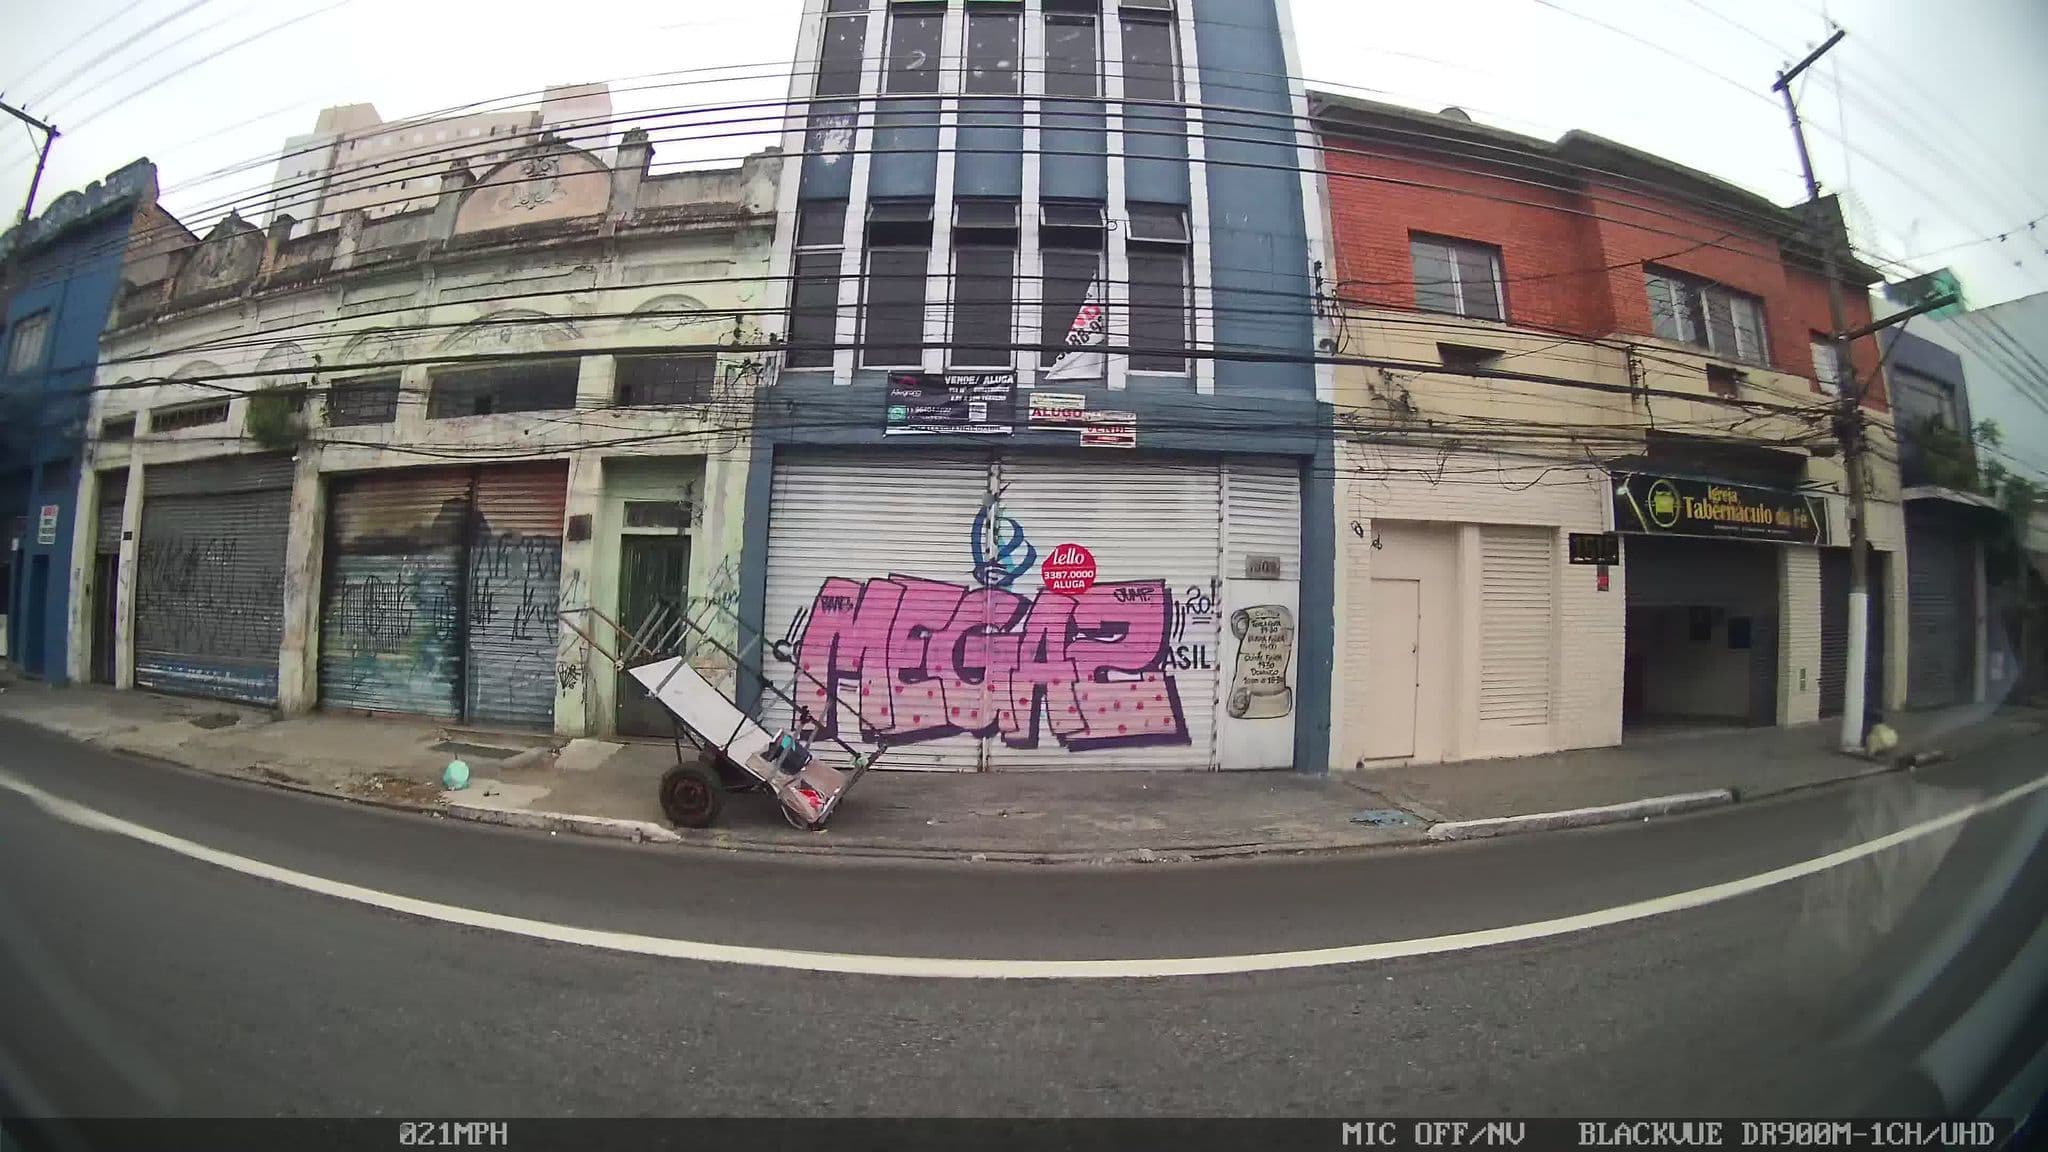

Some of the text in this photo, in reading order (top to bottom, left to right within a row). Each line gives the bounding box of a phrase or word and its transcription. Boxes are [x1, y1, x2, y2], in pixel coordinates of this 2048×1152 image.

[983, 374, 1014, 385] ALUGA
[1031, 407, 1083, 418] ALUGO
[1708, 485, 1738, 503] Igreja
[1053, 547, 1085, 565] lello
[1043, 570, 1094, 580] 3387.0000
[1053, 579, 1085, 590] ALUGA
